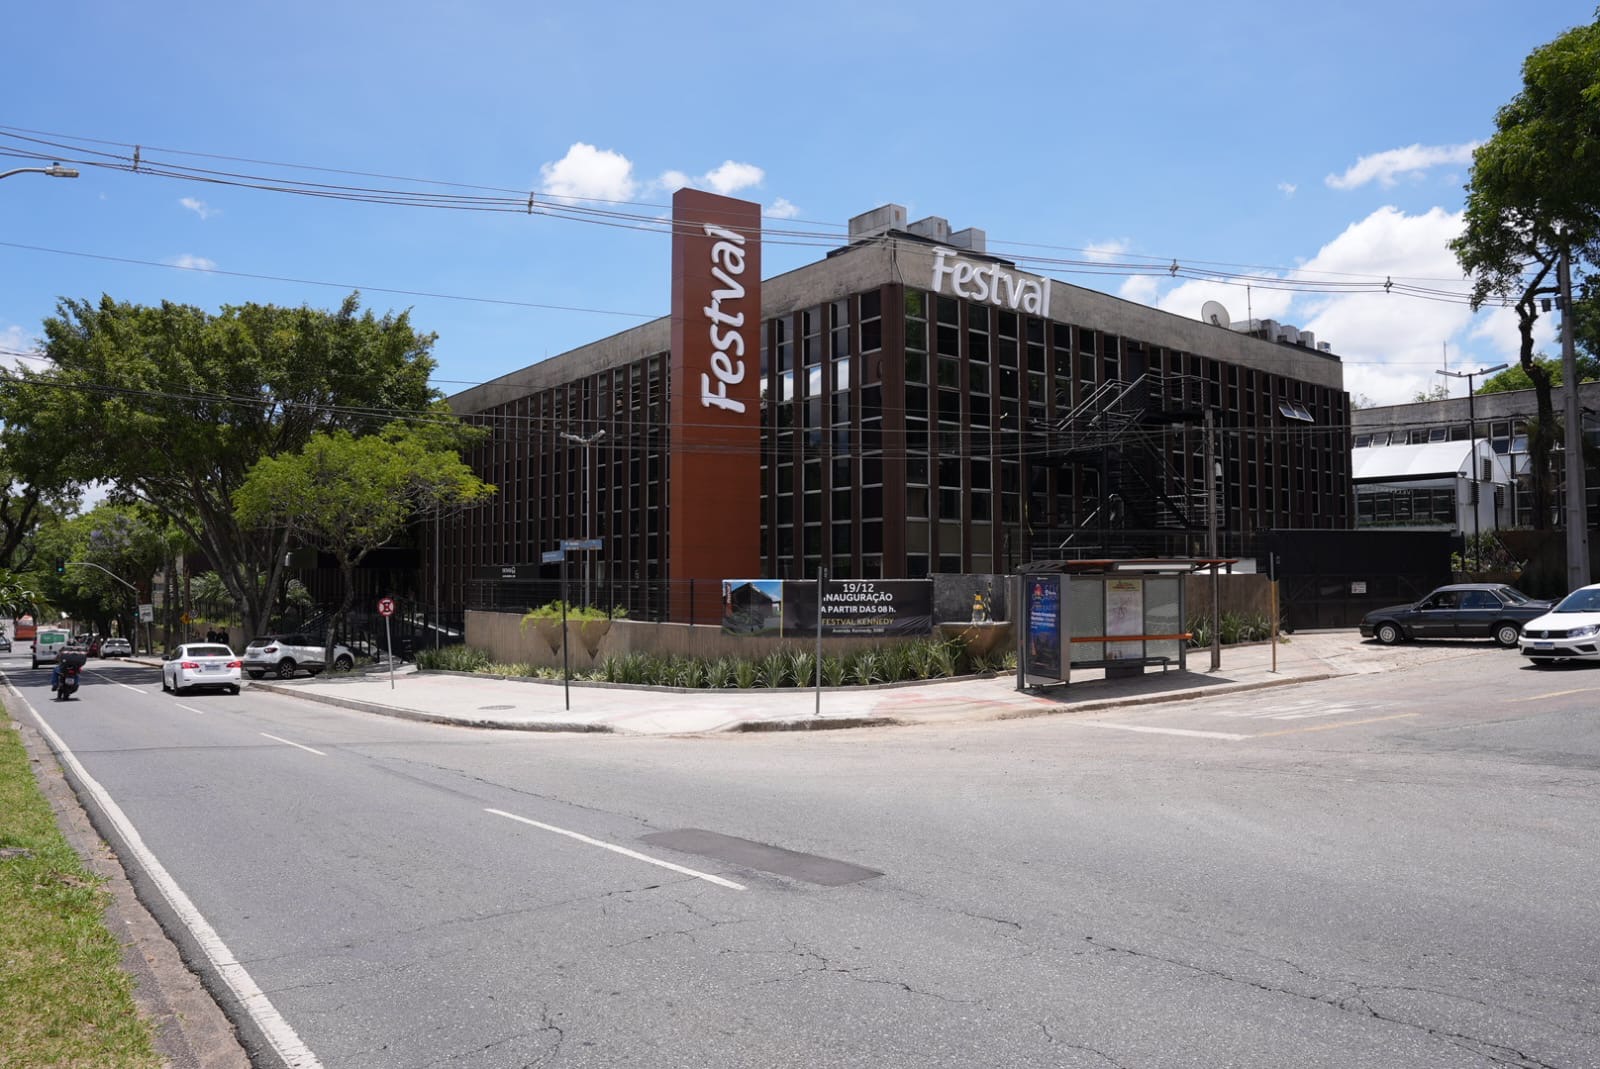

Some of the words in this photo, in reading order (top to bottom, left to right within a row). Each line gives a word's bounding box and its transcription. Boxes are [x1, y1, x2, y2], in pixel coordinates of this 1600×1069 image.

[931, 246, 1052, 317] Festval
[701, 222, 746, 414] Festval
[843, 583, 874, 592] 19/12
[821, 605, 827, 613] A
[828, 605, 858, 613] PARTIR
[859, 605, 877, 613] DAS
[877, 605, 888, 613] 08
